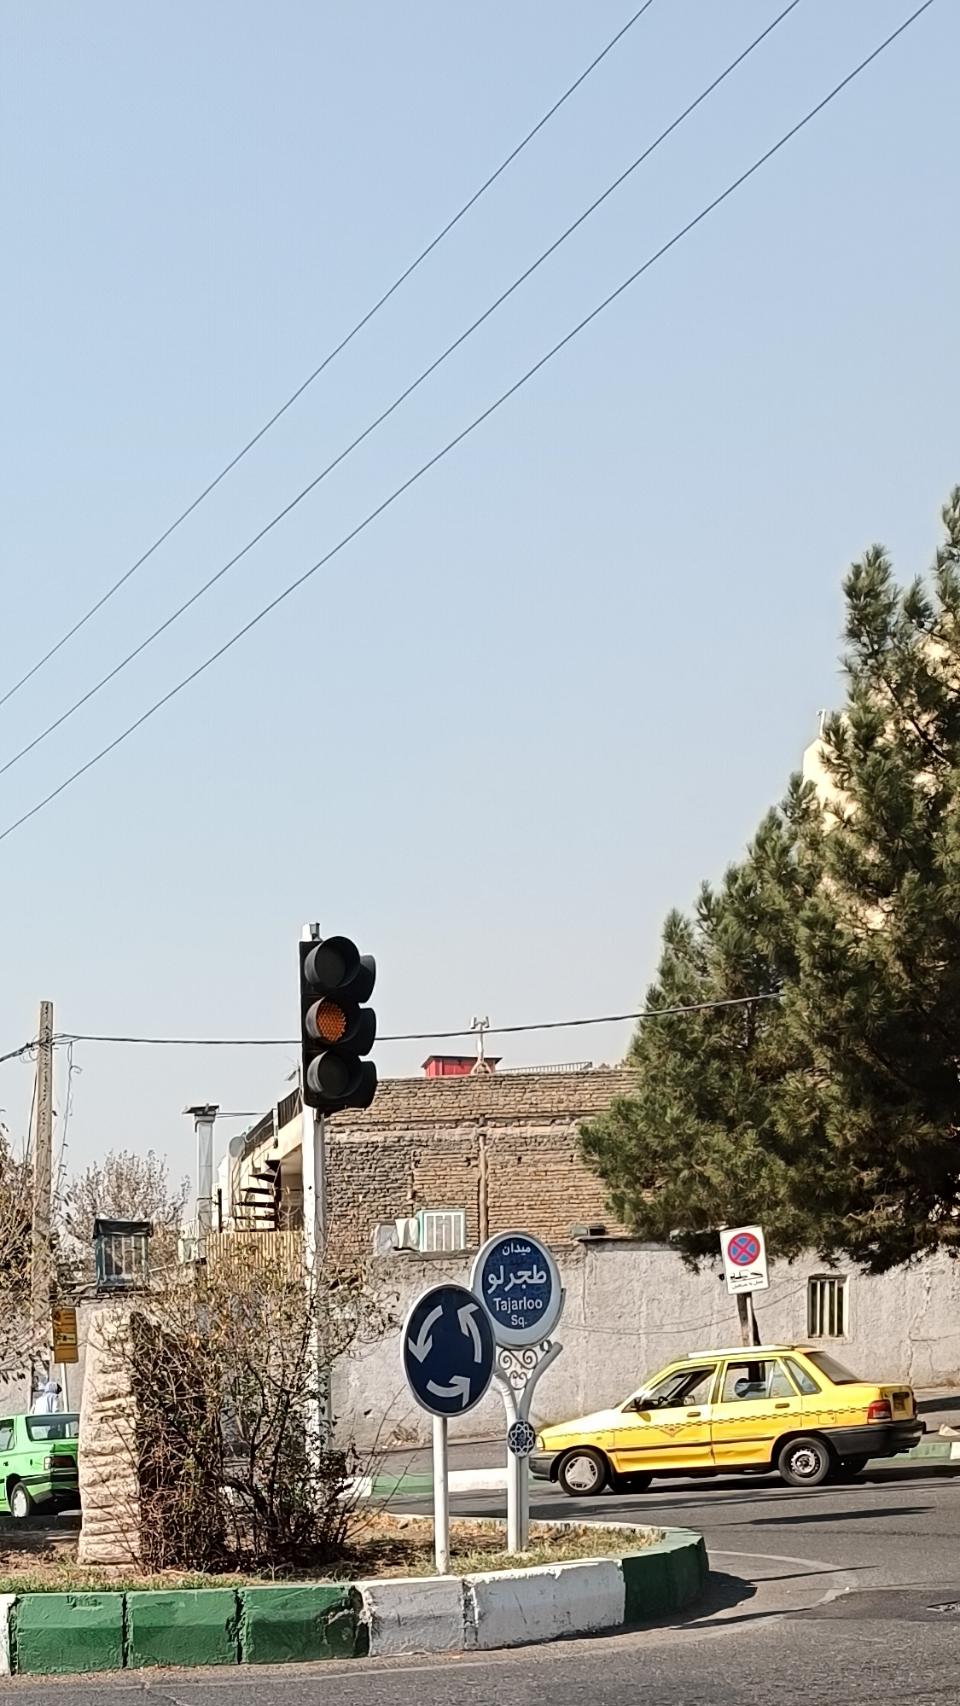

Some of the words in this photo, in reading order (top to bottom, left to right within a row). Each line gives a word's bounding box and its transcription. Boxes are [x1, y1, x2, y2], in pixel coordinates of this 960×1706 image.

[502, 1242, 531, 1256] میدان
[487, 1264, 547, 1295] طجرلو
[493, 1296, 543, 1314] Tajarloo
[510, 1314, 528, 1328] Sq.
